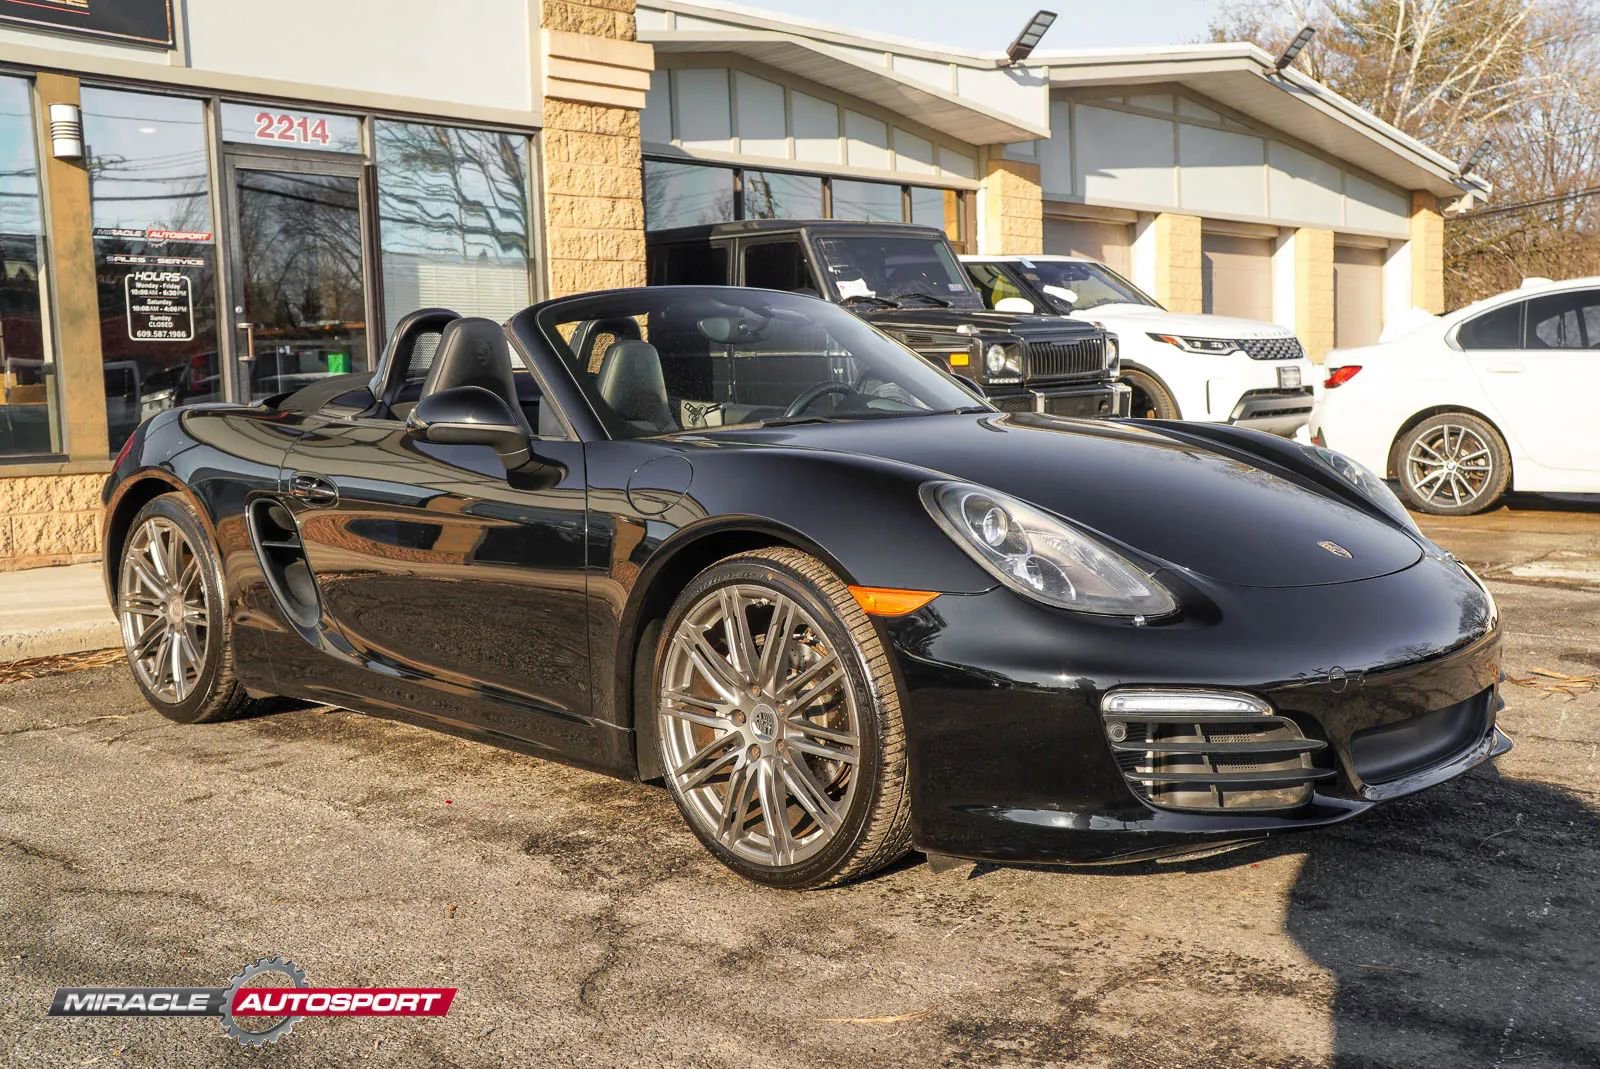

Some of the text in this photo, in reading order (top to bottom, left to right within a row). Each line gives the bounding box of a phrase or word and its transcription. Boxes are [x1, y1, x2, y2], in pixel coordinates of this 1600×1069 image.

[255, 112, 330, 144] 2214
[96, 229, 209, 240] MIRACLE AUTOSPORT
[135, 271, 181, 282] HOURS
